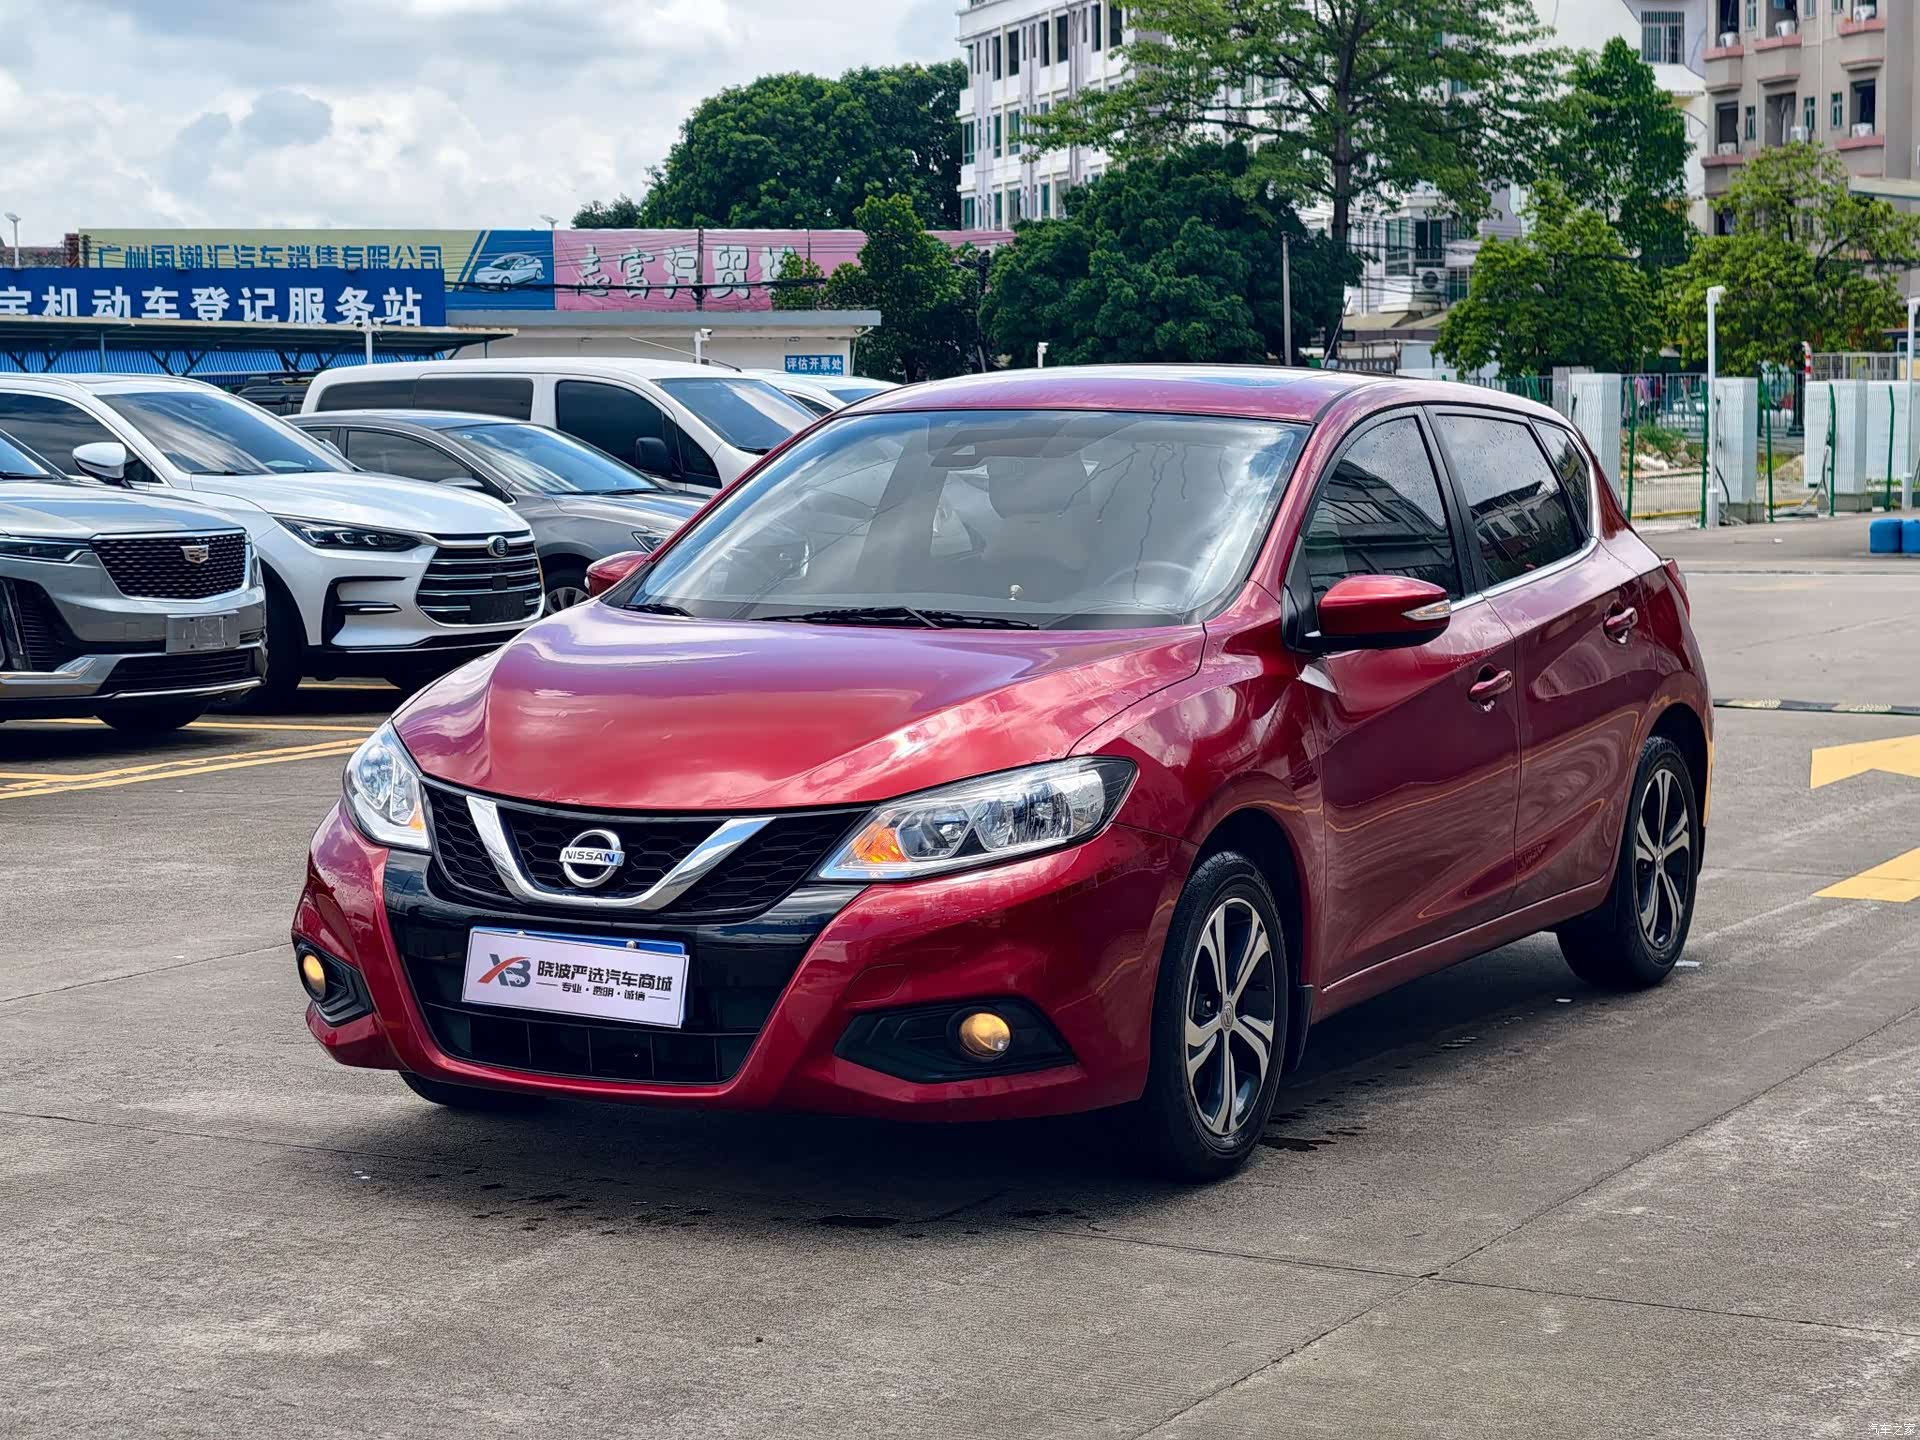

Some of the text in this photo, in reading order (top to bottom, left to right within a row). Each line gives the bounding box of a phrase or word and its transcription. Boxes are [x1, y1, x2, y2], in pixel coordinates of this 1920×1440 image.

[98, 245, 442, 269] 广州国潮汇汽车销售有限公司
[786, 356, 842, 370] 评估开票处
[563, 851, 615, 862] NISSAN
[537, 961, 673, 992] 晓波严选汽车商城
